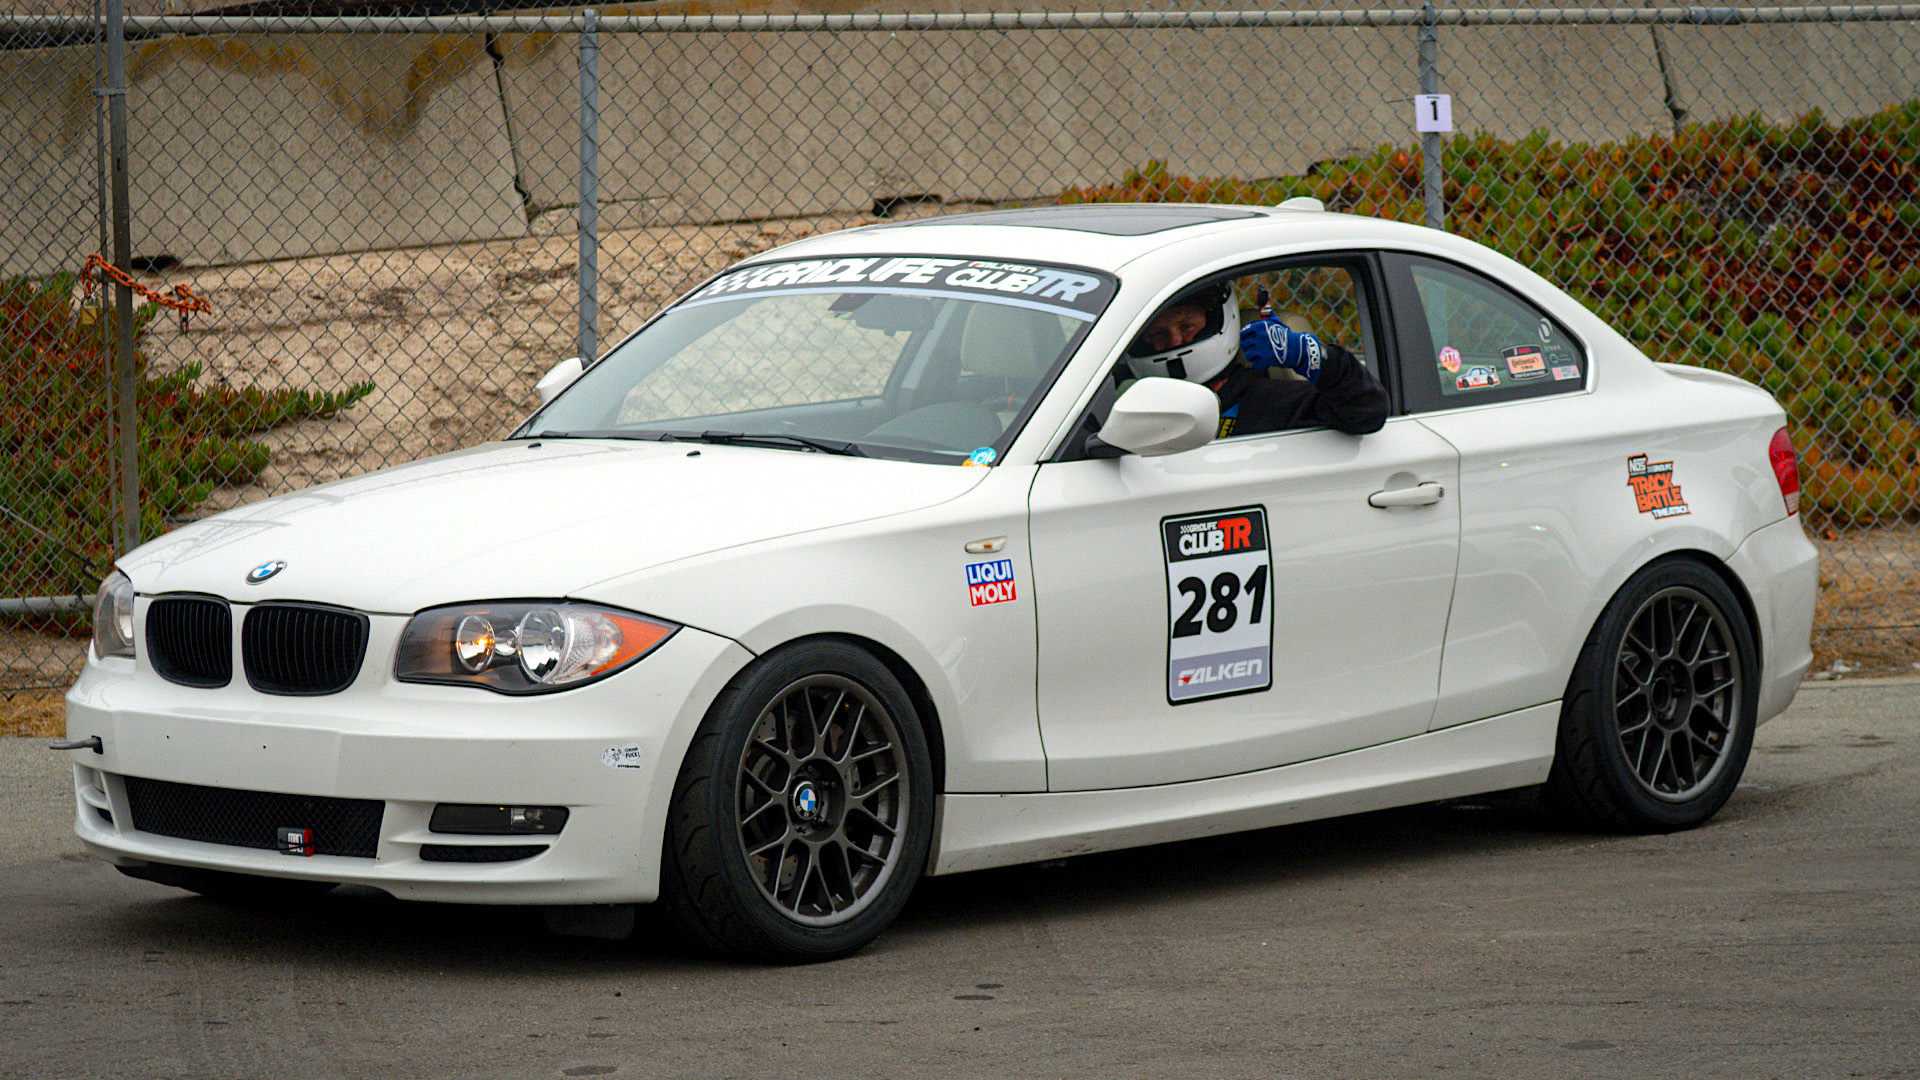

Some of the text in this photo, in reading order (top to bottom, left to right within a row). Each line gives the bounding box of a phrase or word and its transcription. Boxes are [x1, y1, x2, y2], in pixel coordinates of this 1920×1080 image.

[1430, 100, 1438, 120] 1
[746, 257, 968, 289] GRIDLIFE
[968, 261, 1037, 273] FALKEN
[1629, 457, 1647, 473] NOS
[1628, 472, 1674, 496] TRACK
[1637, 487, 1684, 512] BATTLE
[967, 561, 1012, 584] LIQUI
[971, 581, 1014, 605] MOLY
[1172, 565, 1268, 639] 281
[1177, 659, 1263, 687] FALKEN
